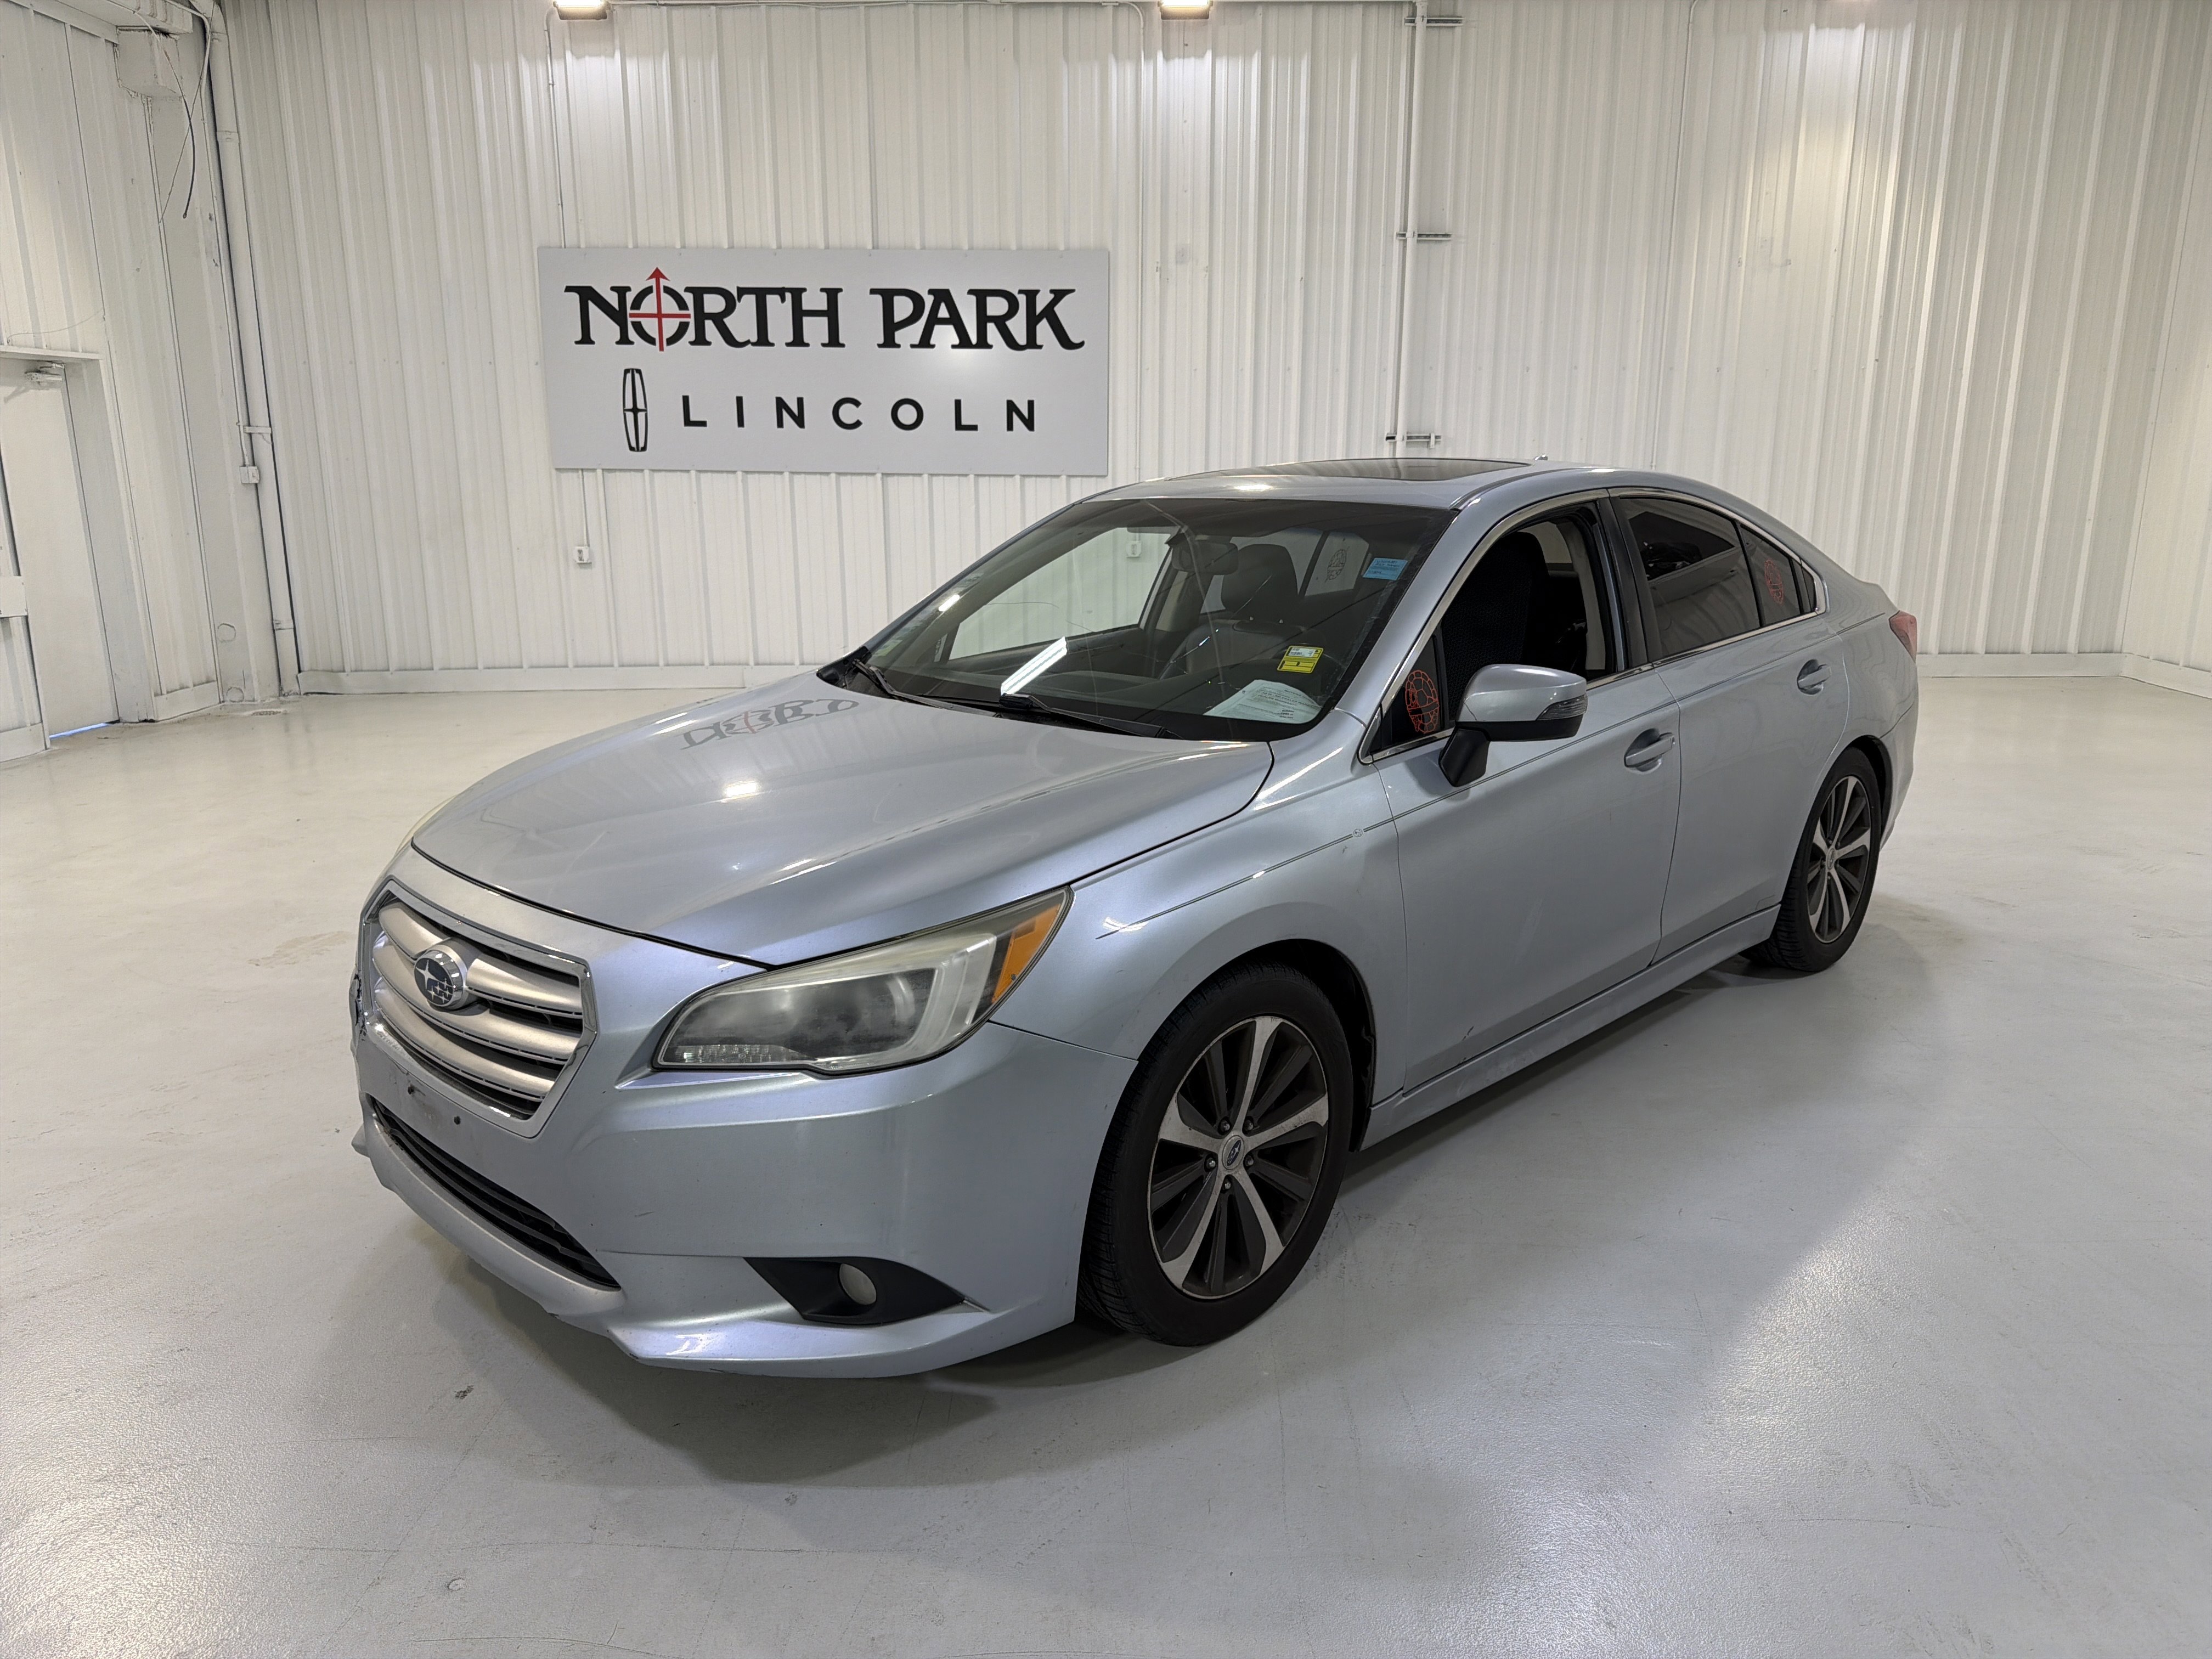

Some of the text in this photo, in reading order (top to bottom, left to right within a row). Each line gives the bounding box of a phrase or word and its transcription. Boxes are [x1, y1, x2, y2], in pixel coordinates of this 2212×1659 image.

[564, 285, 1085, 351] NORTH PARK
[682, 395, 1034, 431] LINCOLN
